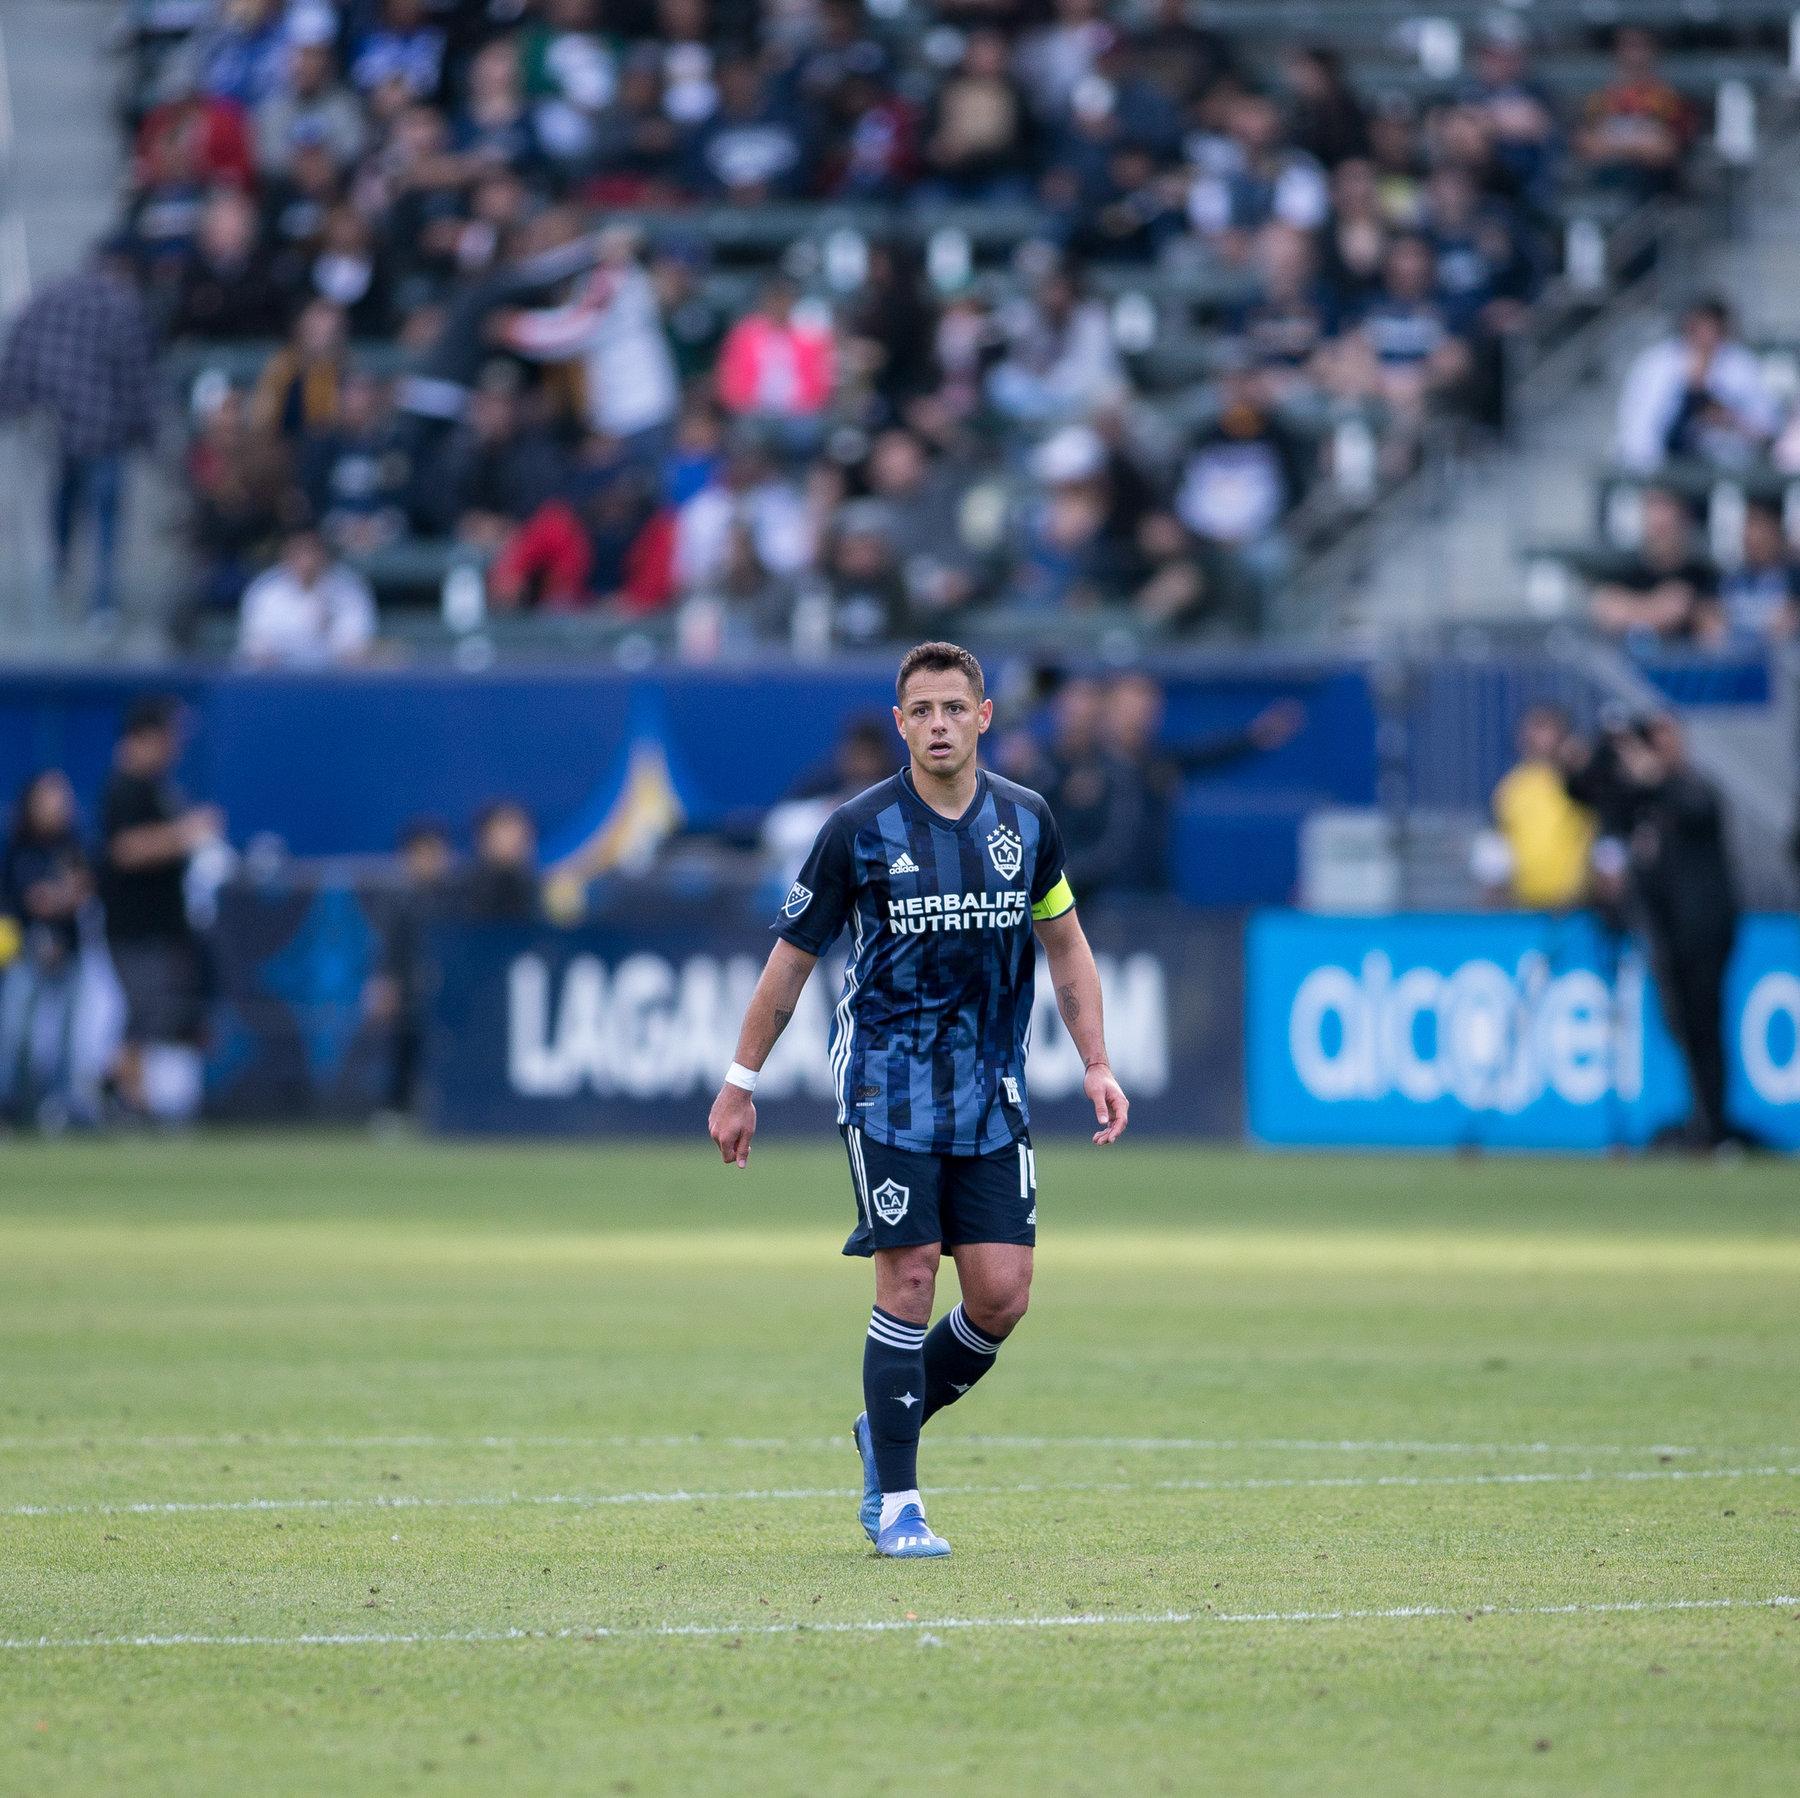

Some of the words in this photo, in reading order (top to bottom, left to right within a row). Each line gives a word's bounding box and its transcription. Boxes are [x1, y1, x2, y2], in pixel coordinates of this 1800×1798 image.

[997, 850, 1016, 863] LA
[889, 864, 919, 875] adidas
[888, 891, 1026, 917] HERBALIFE
[889, 910, 1025, 935] NUTRITION
[881, 1195, 902, 1208] LA
